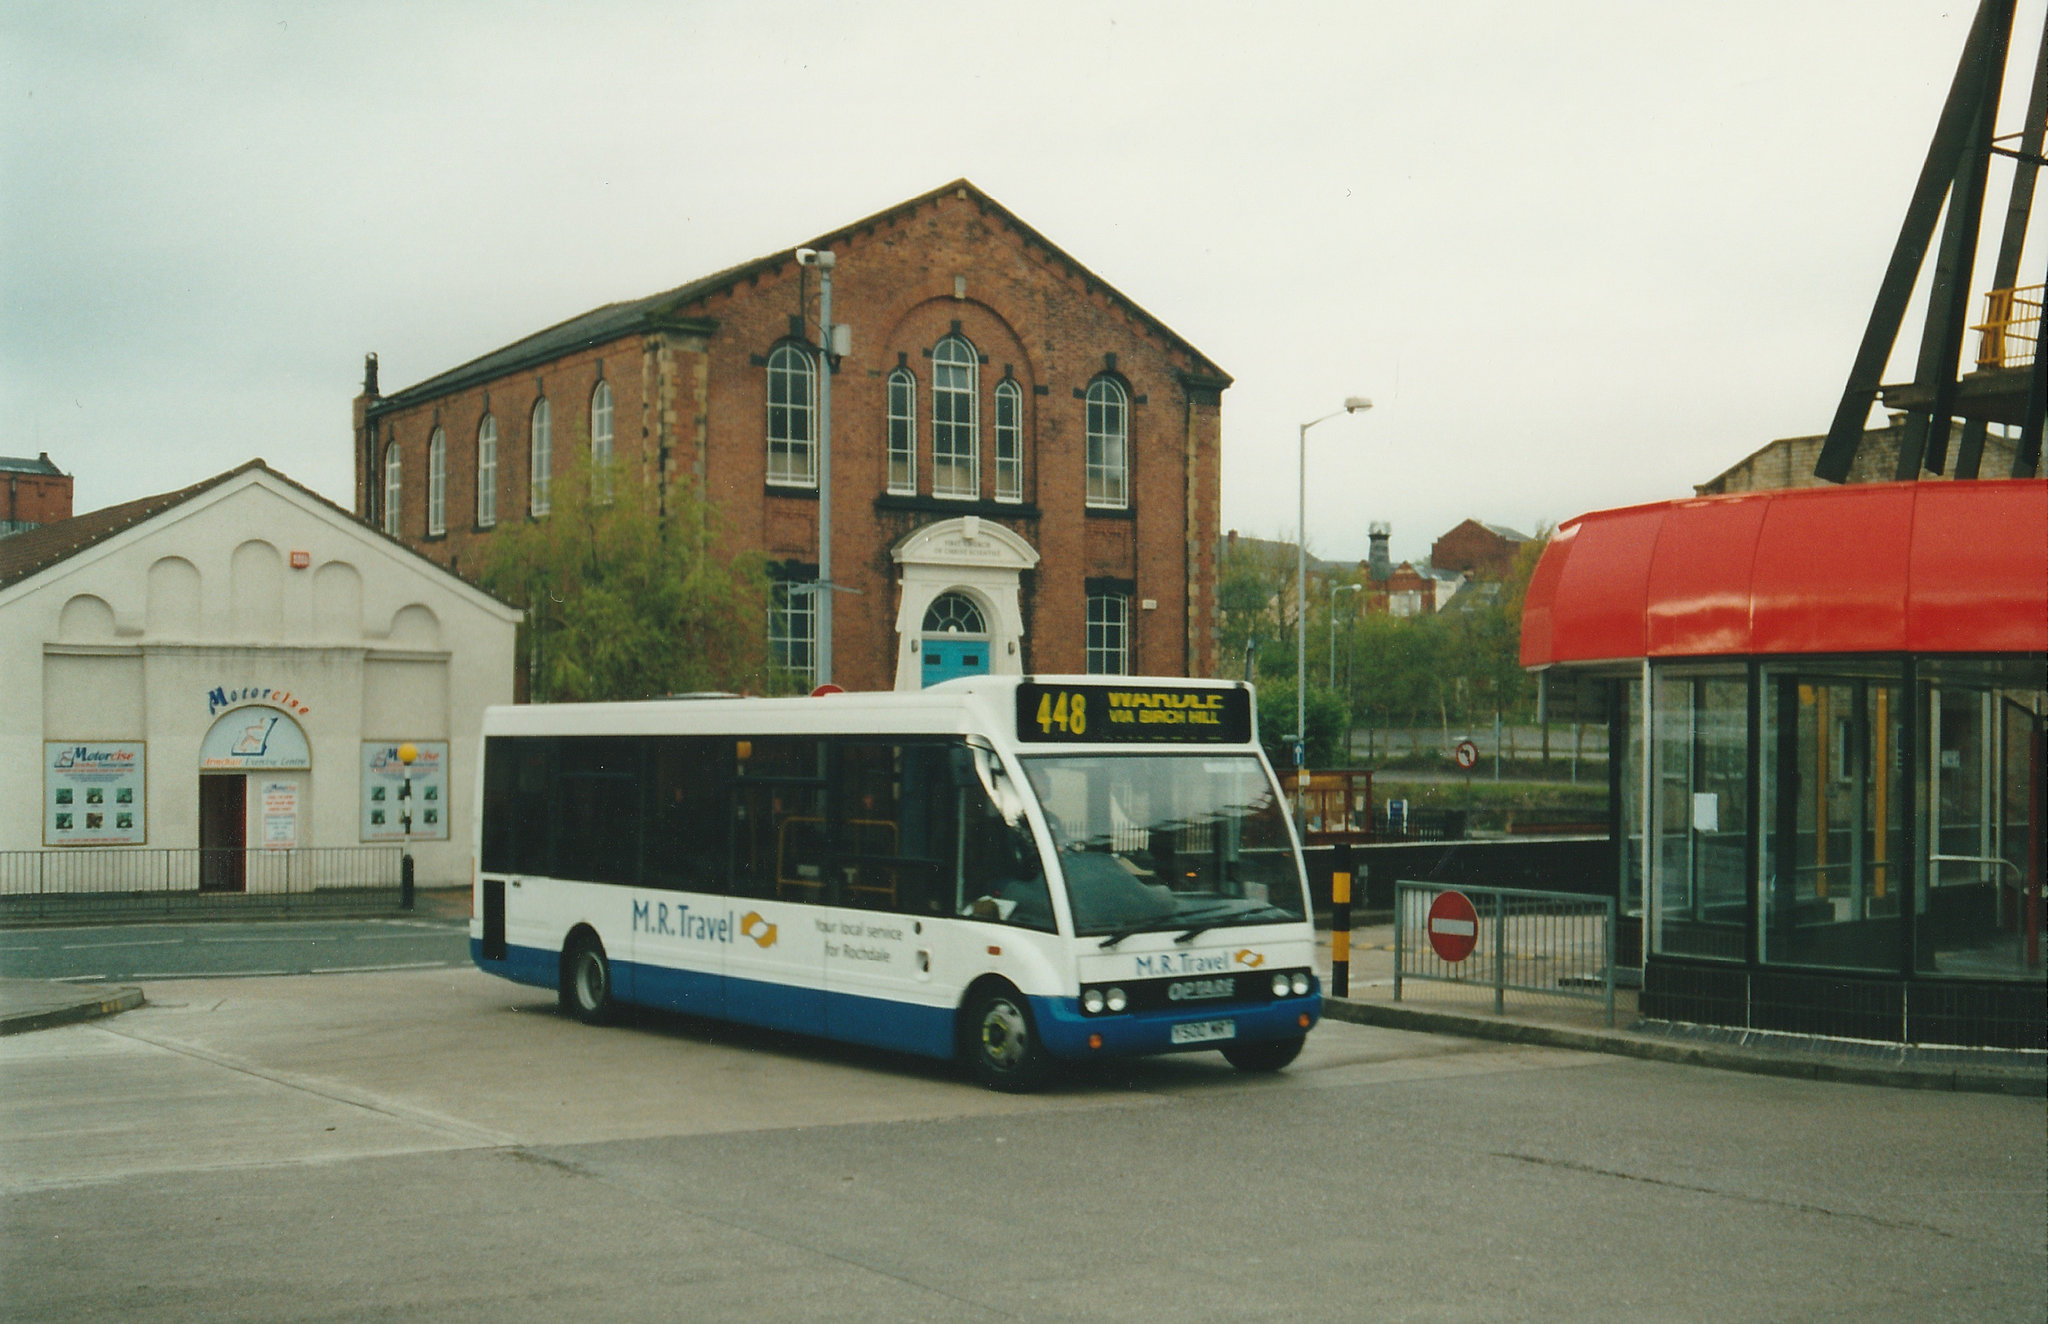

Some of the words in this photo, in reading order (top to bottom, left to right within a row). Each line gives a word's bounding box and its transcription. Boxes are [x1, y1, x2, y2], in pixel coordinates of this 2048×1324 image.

[208, 686, 309, 715] Motorcise
[1108, 691, 1224, 709] WARDLE
[1036, 691, 1087, 735] 448
[1109, 709, 1135, 723] VIA
[1138, 710, 1186, 724] BIRCH
[1188, 711, 1221, 724] HILL
[73, 747, 134, 761] Motorcise
[205, 757, 242, 766] Armchair
[245, 757, 277, 766] Exercise
[281, 758, 306, 766] Centre
[815, 919, 837, 933] Your
[840, 921, 863, 936] local
[867, 924, 903, 941] service
[825, 940, 839, 957] for
[843, 943, 891, 962] Rochdale
[1168, 978, 1235, 1000] OPTARE
